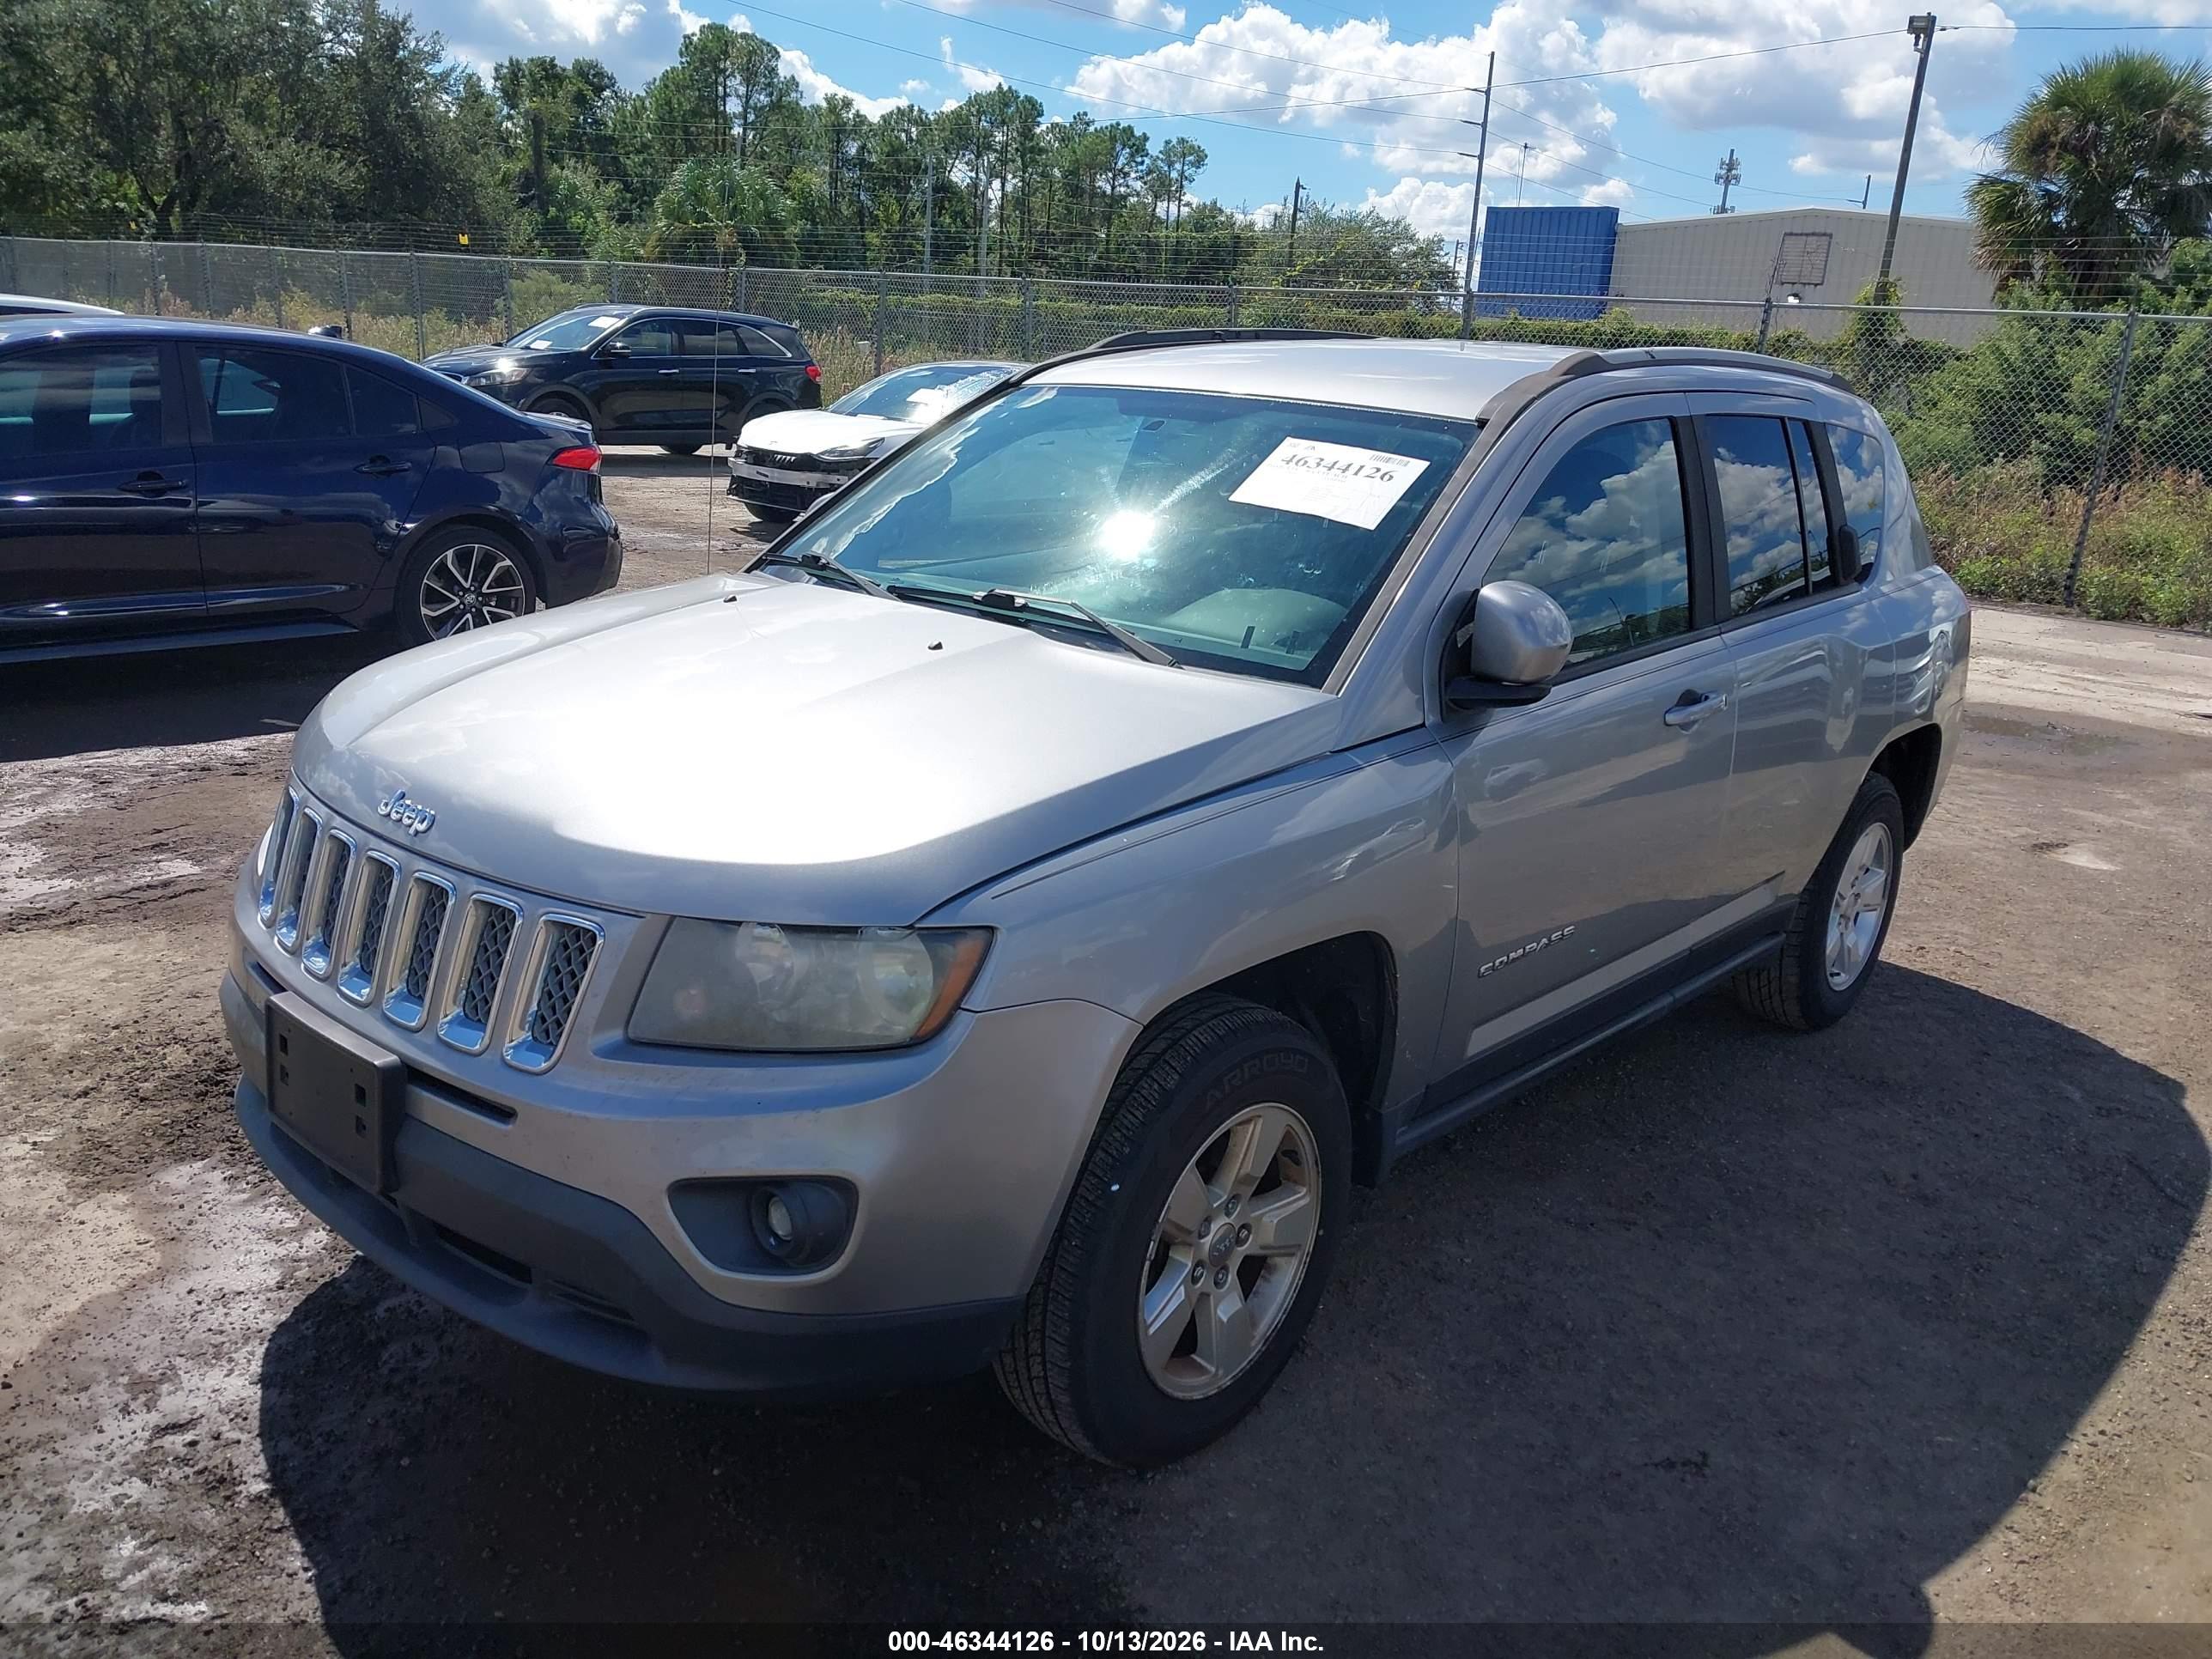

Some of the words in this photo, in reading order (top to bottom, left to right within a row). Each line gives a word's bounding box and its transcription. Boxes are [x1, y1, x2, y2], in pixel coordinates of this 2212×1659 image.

[1280, 453, 1399, 483] 46344126
[377, 789, 435, 836] Jeep
[1478, 926, 1575, 977] COMPASS
